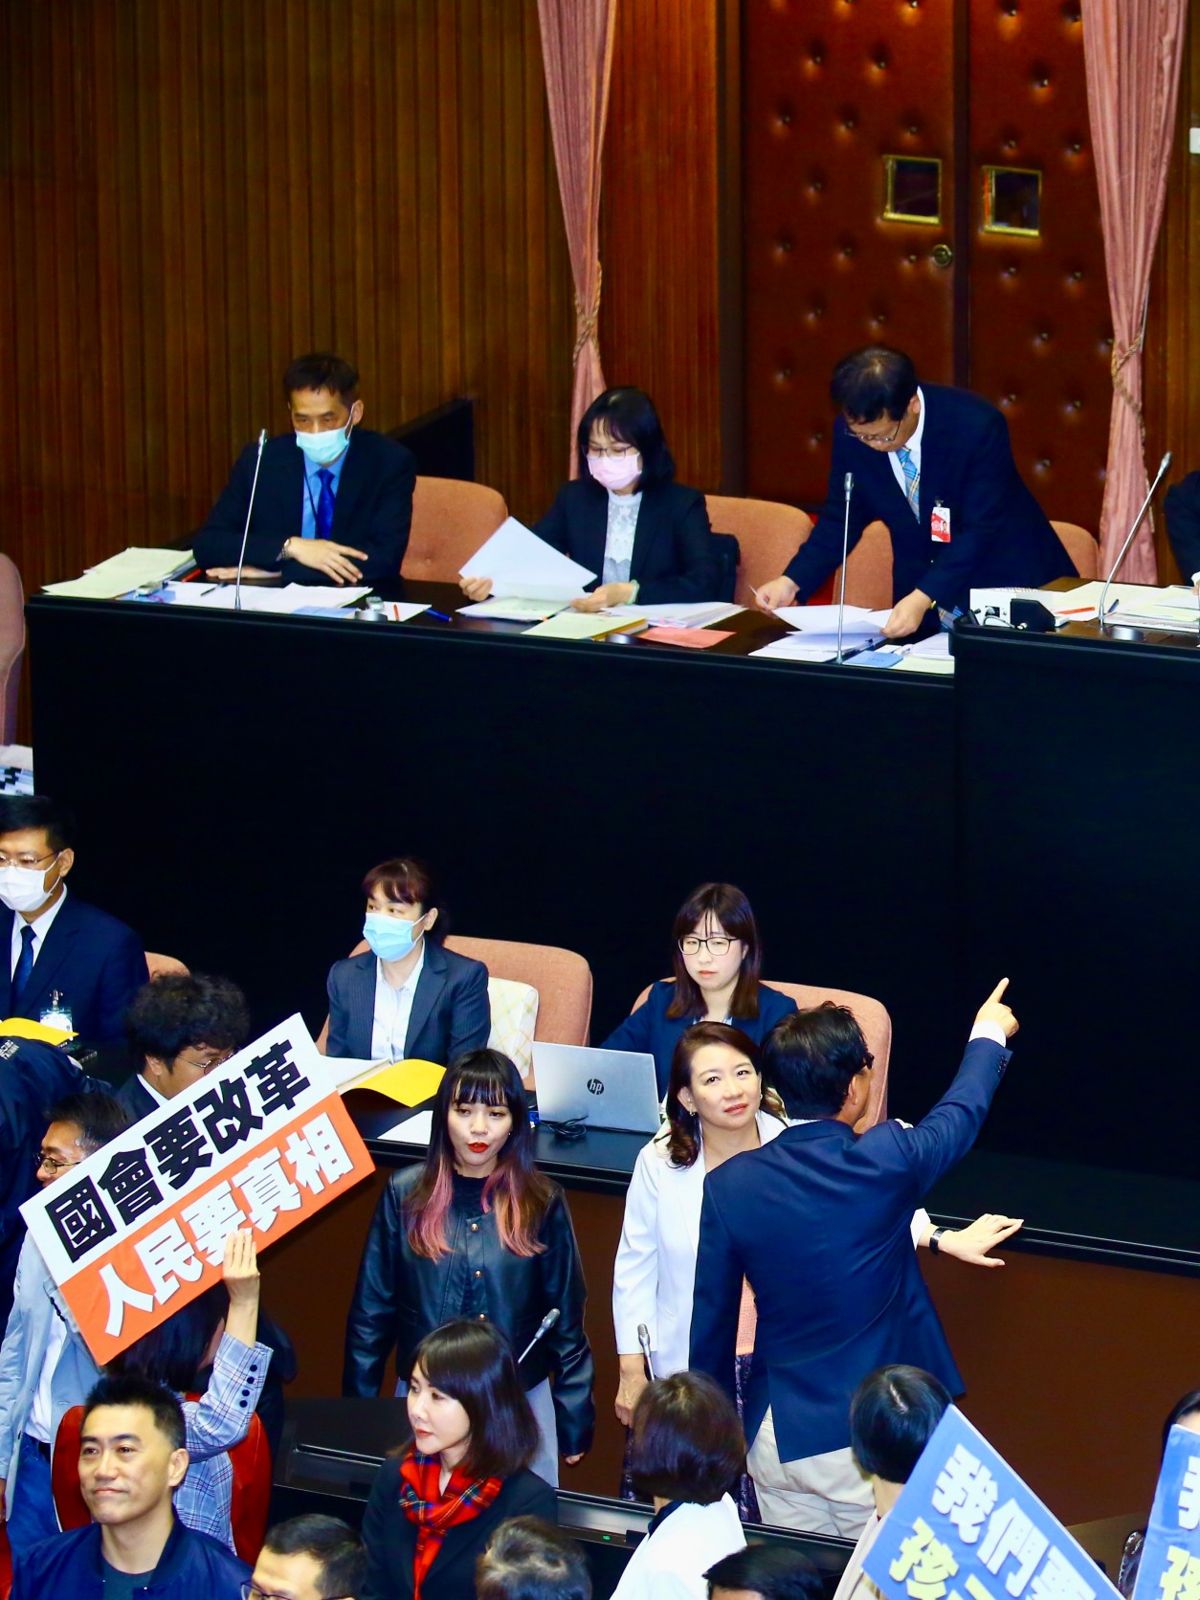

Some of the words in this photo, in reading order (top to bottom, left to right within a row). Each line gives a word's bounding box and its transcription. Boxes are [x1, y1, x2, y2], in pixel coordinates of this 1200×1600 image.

[45, 1039, 311, 1263] 國會要改革
[587, 1078, 604, 1095] hp
[98, 1112, 353, 1337] 人民要真相
